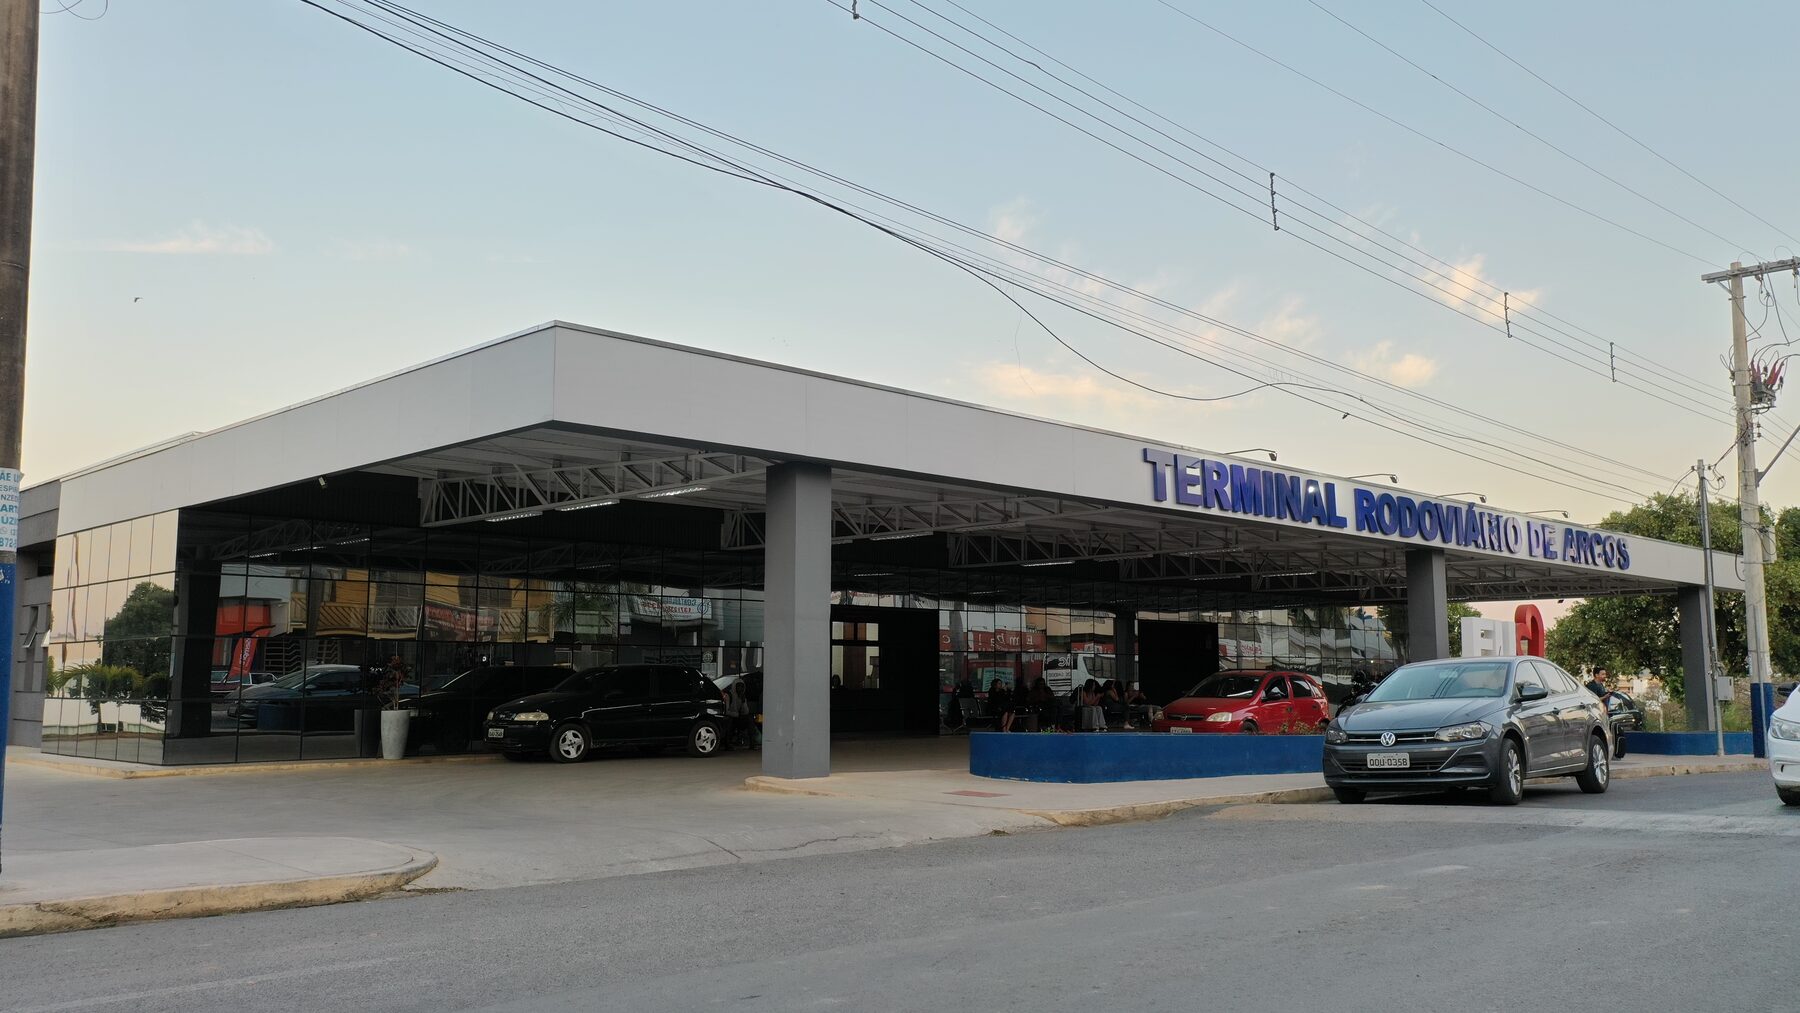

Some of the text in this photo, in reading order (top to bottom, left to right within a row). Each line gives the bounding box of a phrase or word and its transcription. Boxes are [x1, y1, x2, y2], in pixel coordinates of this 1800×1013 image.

[1143, 447, 1631, 571] TERMINAL RODOVIÁRIO DE ARCOS
